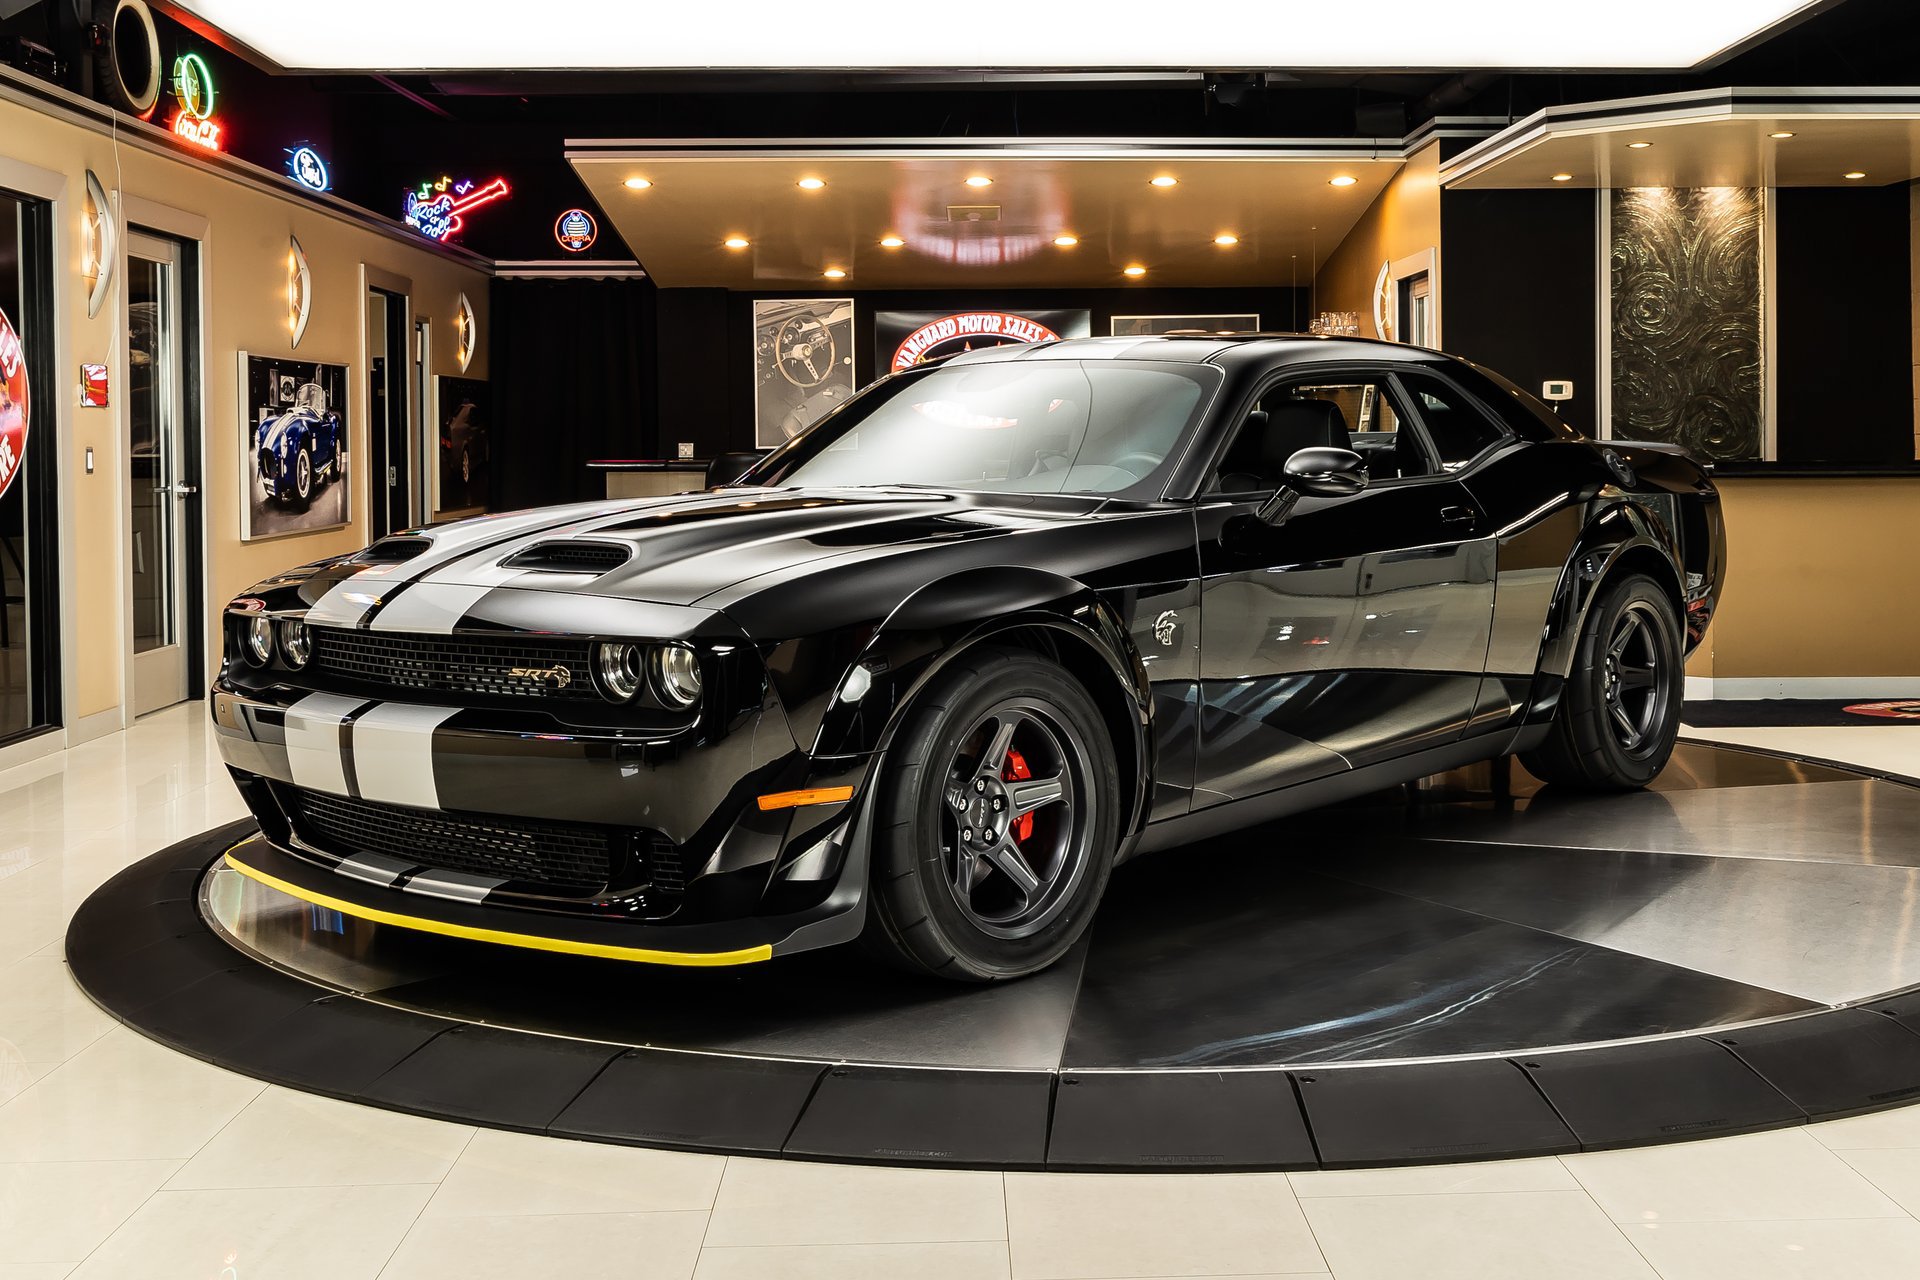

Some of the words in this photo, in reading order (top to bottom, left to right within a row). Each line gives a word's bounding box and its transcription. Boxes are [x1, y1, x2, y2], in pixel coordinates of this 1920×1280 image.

[896, 318, 957, 368] VANGUARD
[957, 314, 1001, 334] MOTOR
[508, 667, 558, 681] SRT
